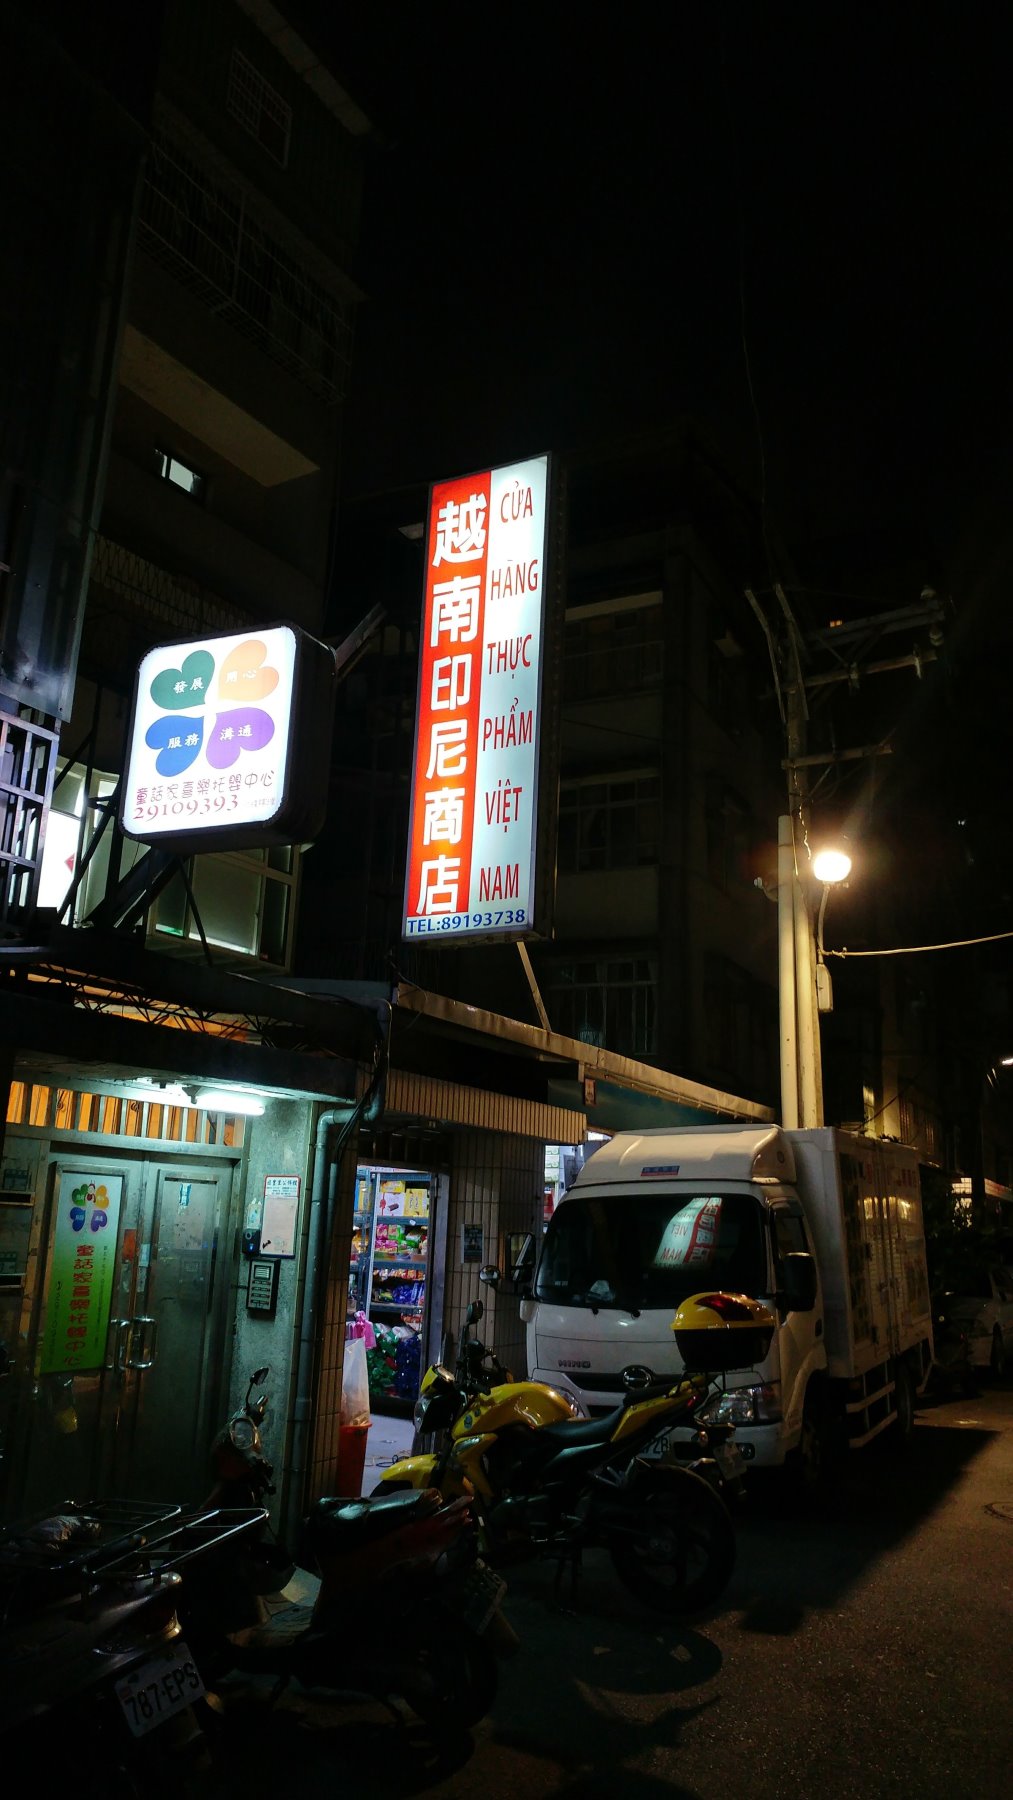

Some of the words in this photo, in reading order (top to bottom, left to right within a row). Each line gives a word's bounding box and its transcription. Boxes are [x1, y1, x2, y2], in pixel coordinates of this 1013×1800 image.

[500, 480, 534, 524] CỬA
[486, 634, 533, 680] THỰC
[173, 677, 205, 694] 發展
[415, 491, 488, 915] 越南印尼商店
[167, 733, 200, 749] 服務
[482, 697, 534, 752] PHẨM
[131, 794, 239, 823] 29109393
[485, 779, 523, 833] VIỆT
[479, 863, 520, 903] NAM
[406, 908, 526, 934] TEL:89193738
[124, 1661, 200, 1727] 787-EPS
